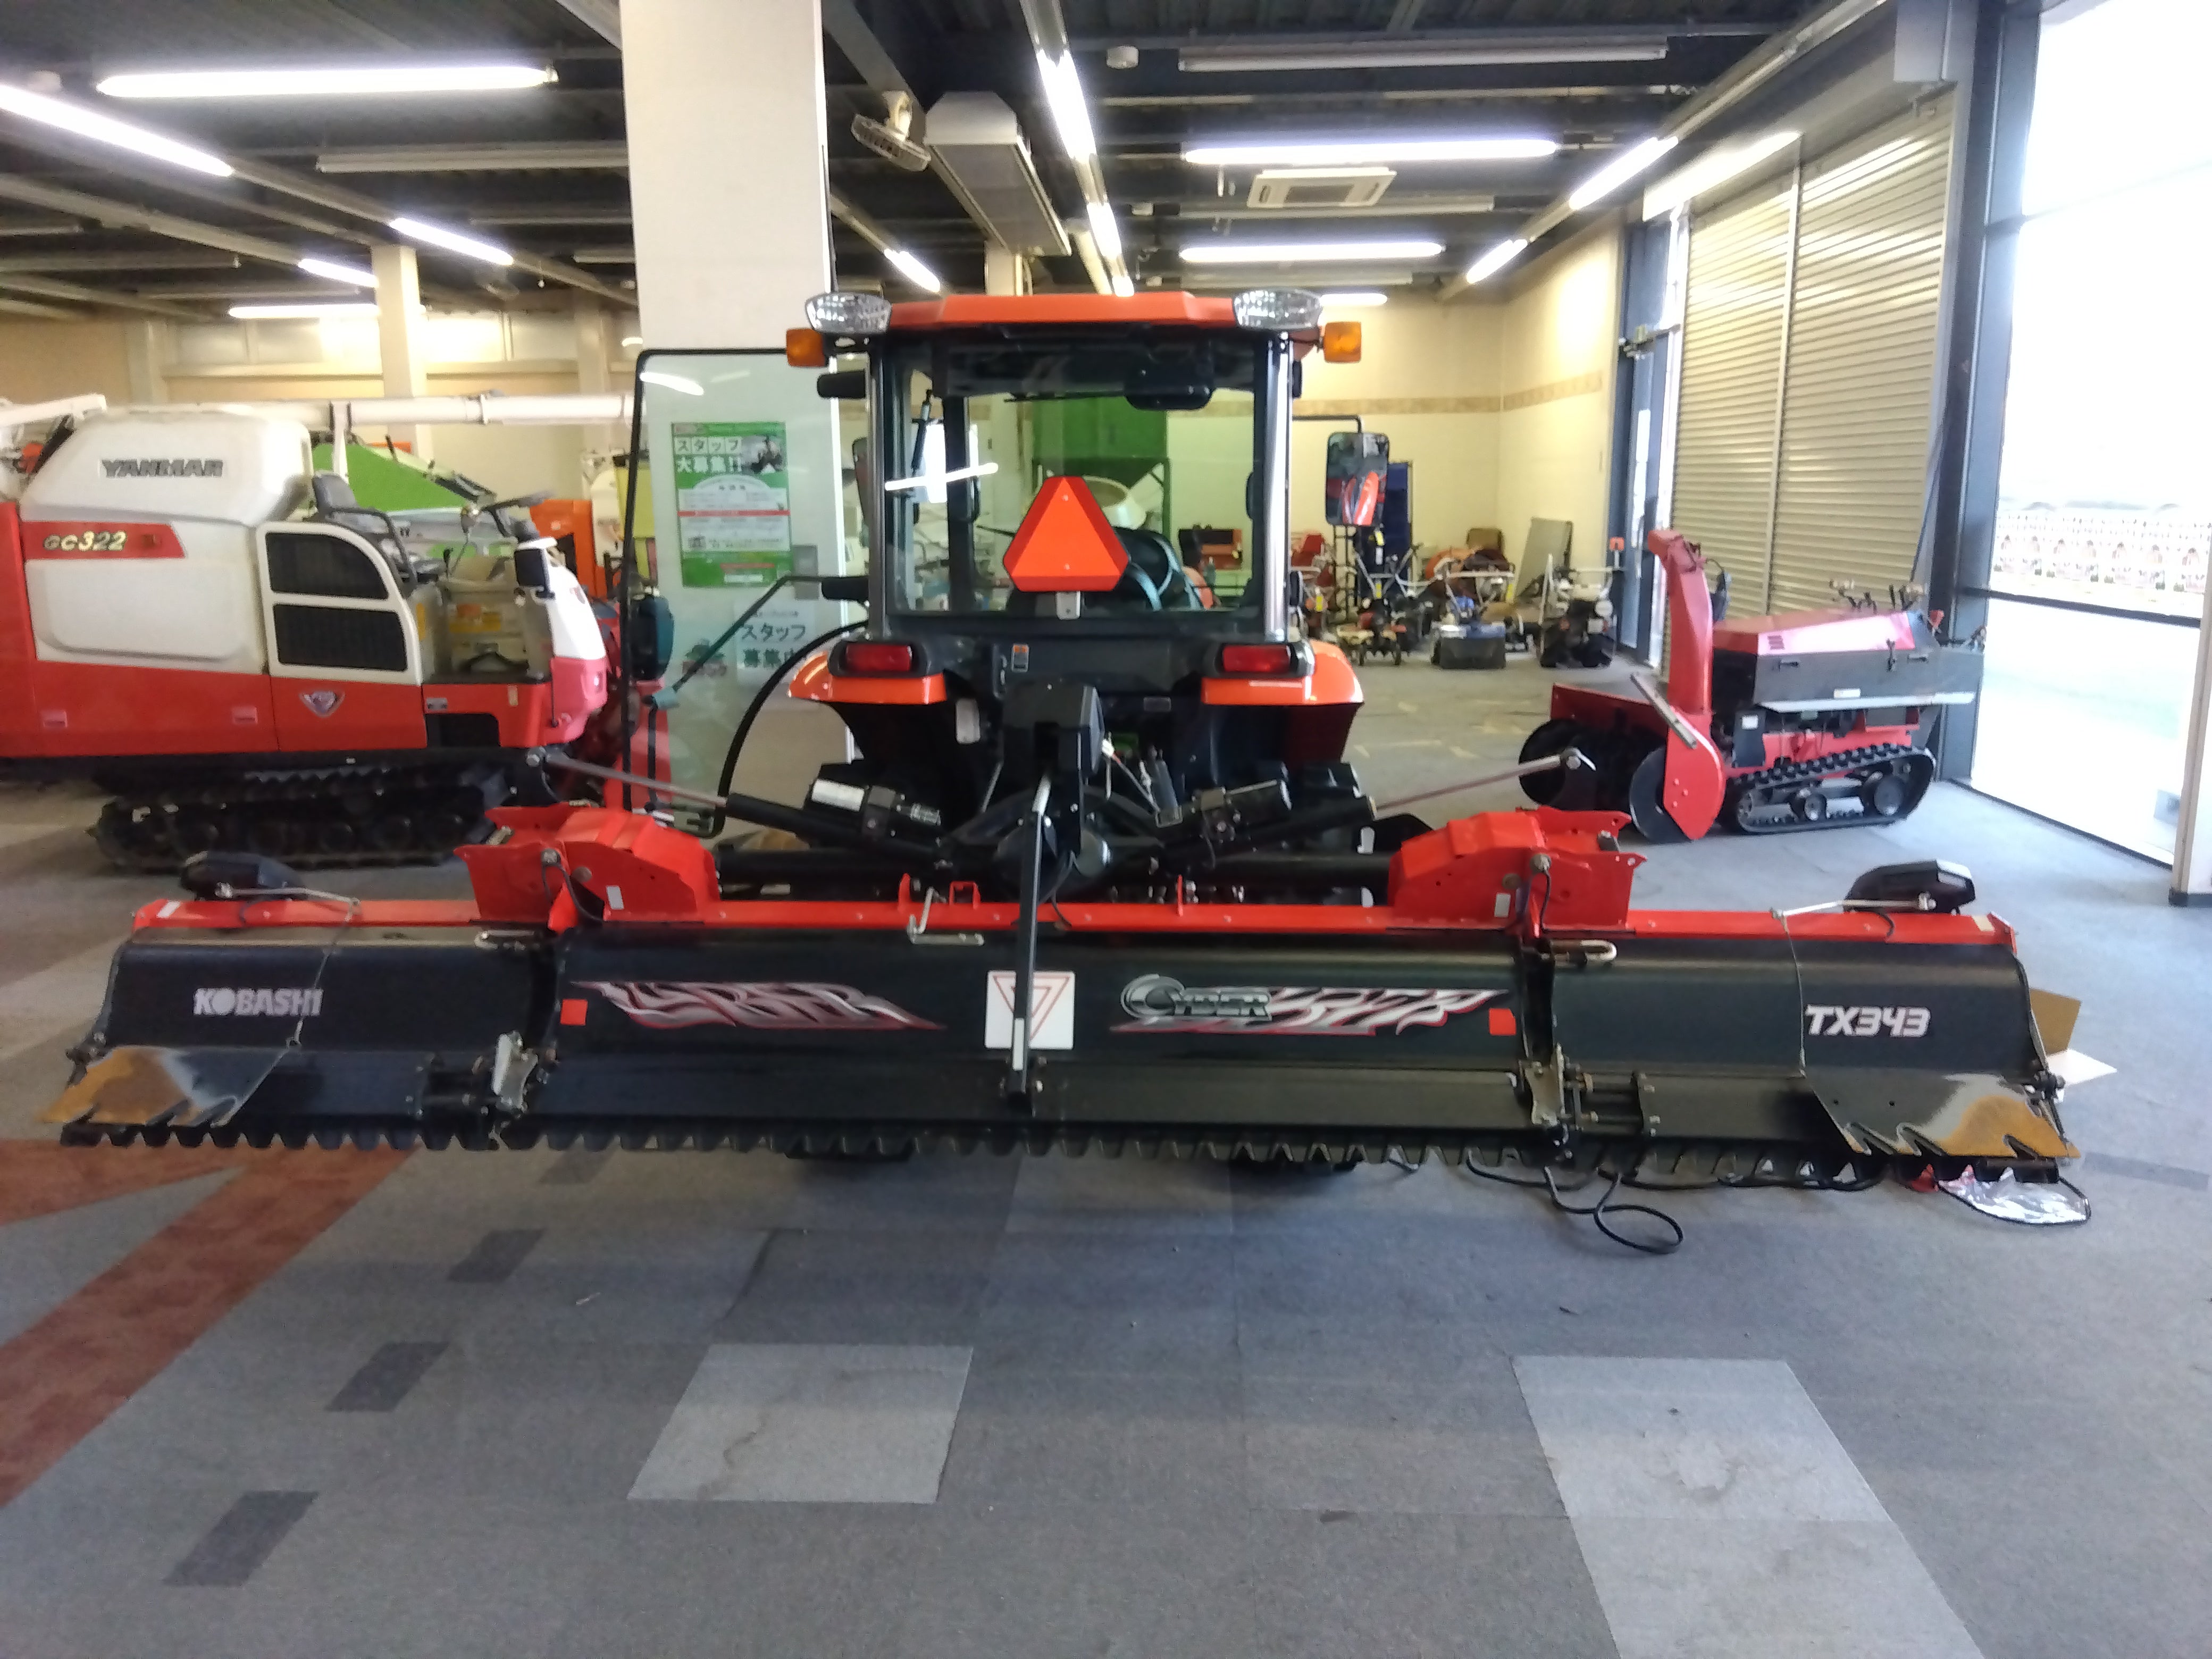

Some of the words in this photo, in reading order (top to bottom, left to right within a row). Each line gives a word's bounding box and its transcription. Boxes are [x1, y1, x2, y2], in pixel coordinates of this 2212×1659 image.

[676, 438, 740, 453] スタッフ
[101, 458, 223, 477] YANMAR
[741, 622, 806, 642] スタッフ
[193, 987, 323, 1016] KOBASHI
[1805, 1004, 1932, 1037] TX343
